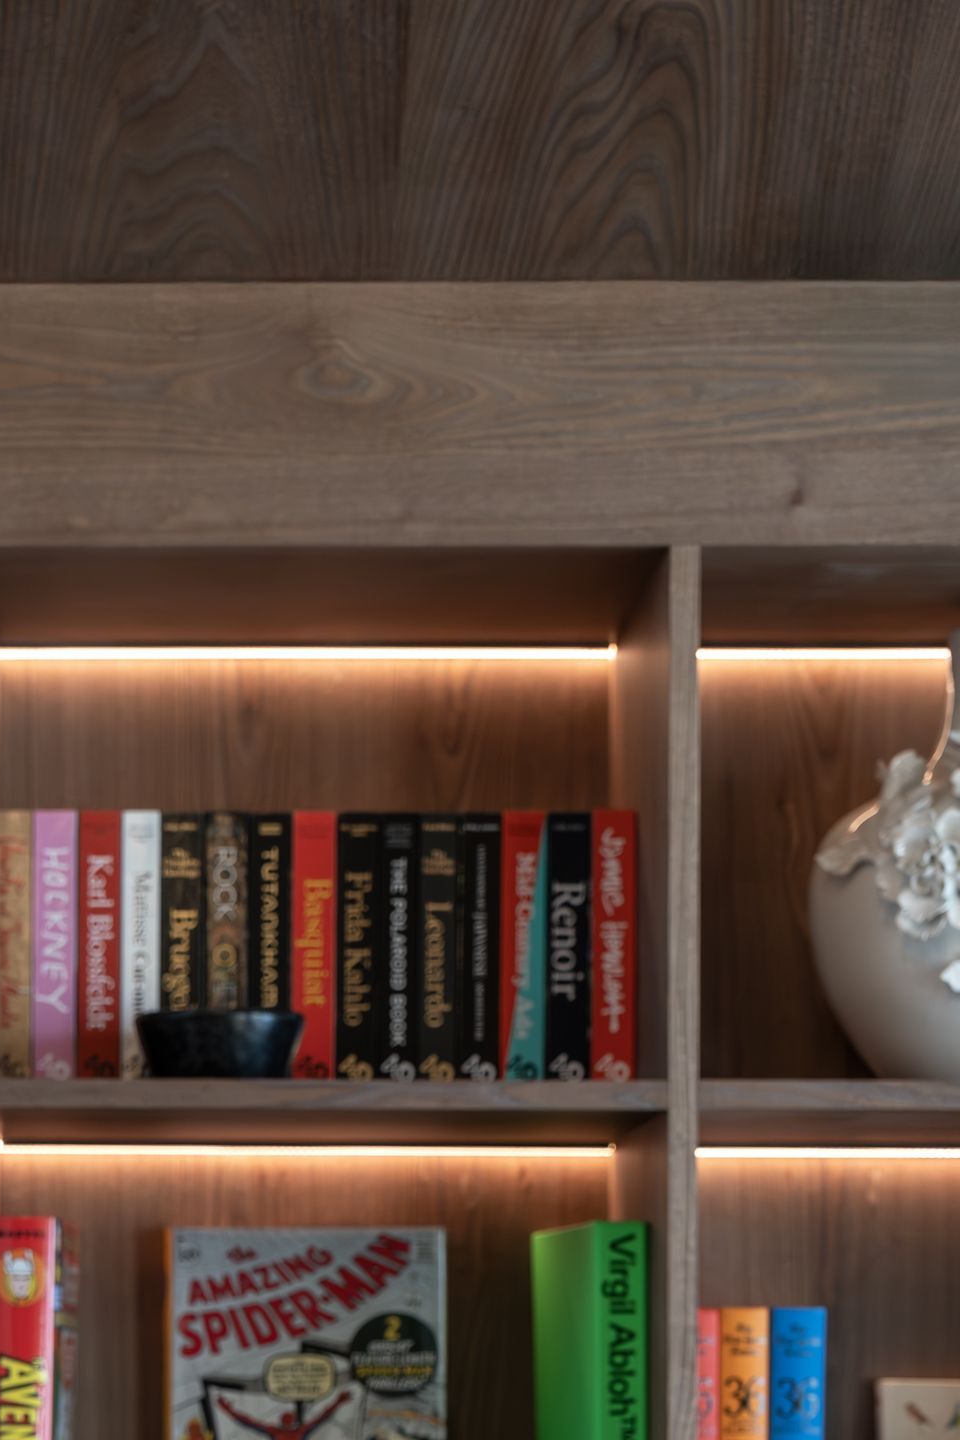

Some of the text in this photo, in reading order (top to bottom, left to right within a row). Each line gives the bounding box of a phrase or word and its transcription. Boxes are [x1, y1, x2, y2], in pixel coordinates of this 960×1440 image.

[213, 846, 238, 921] ROCK
[343, 871, 372, 943] Frida
[390, 856, 408, 893] THE
[34, 846, 70, 1015] HOCKNEY
[86, 854, 116, 1031] Karl Blossfeldt
[295, 878, 333, 1008] Basquiat
[390, 897, 408, 991] POLAROID
[424, 901, 453, 1028] Leonardo
[551, 882, 586, 1002] Renoir
[343, 949, 371, 1028] Kahlo
[390, 993, 408, 1047] BOOK
[177, 1232, 413, 1358] SPIDER-MAN
[187, 1245, 333, 1306] AMAZING
[601, 1233, 637, 1315] Virgil
[384, 1315, 401, 1341] 2
[722, 1376, 767, 1420] 36
[774, 1376, 821, 1420] 36
